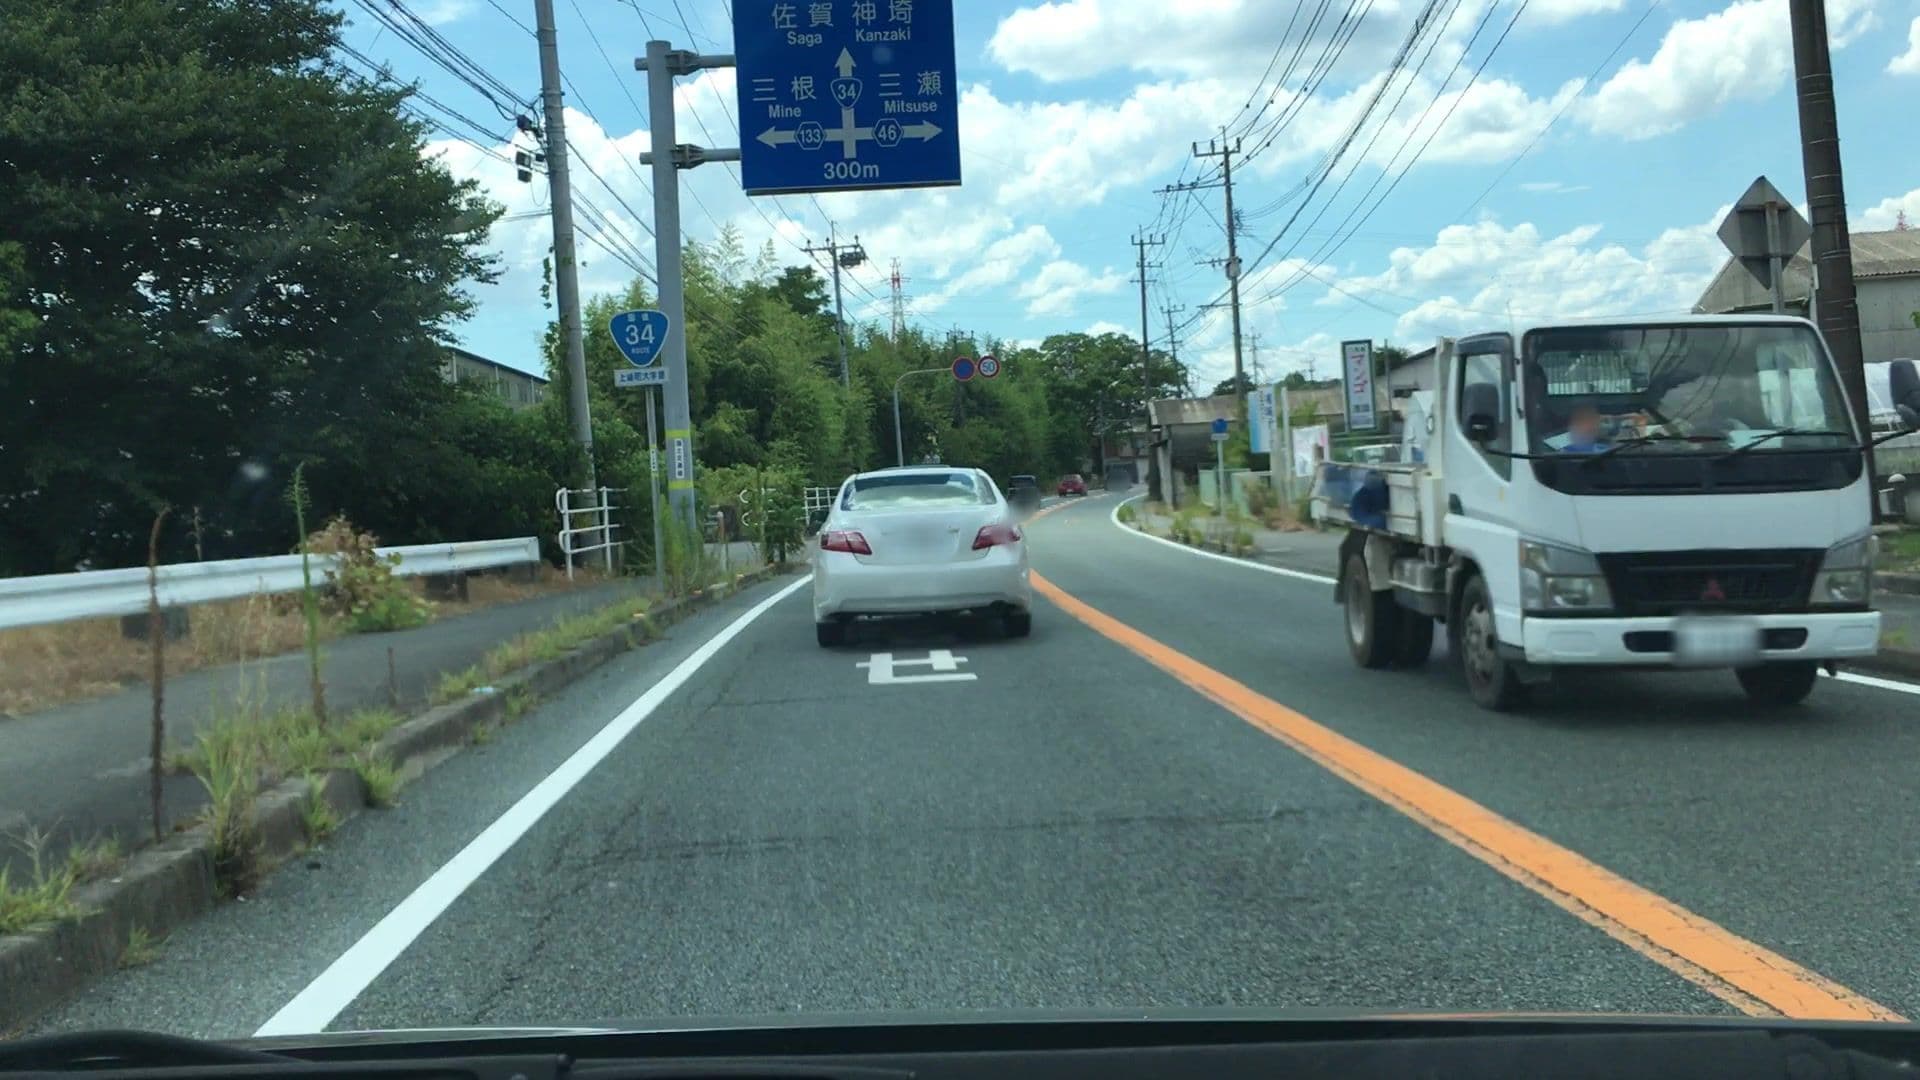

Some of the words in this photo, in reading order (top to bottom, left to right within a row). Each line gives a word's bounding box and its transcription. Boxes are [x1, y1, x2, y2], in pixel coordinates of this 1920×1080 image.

[772, 2, 833, 28] 佐賀
[787, 32, 822, 47] Saga
[855, 27, 911, 42] Kanzaki
[752, 76, 816, 102] 三根
[838, 83, 856, 99] 34
[878, 71, 942, 97] 三瀬
[768, 105, 802, 119] Mine
[884, 100, 937, 114] Mitsuse
[800, 129, 821, 143] 133
[877, 125, 897, 141] 46
[823, 161, 879, 180] 300m
[625, 324, 655, 345] 34
